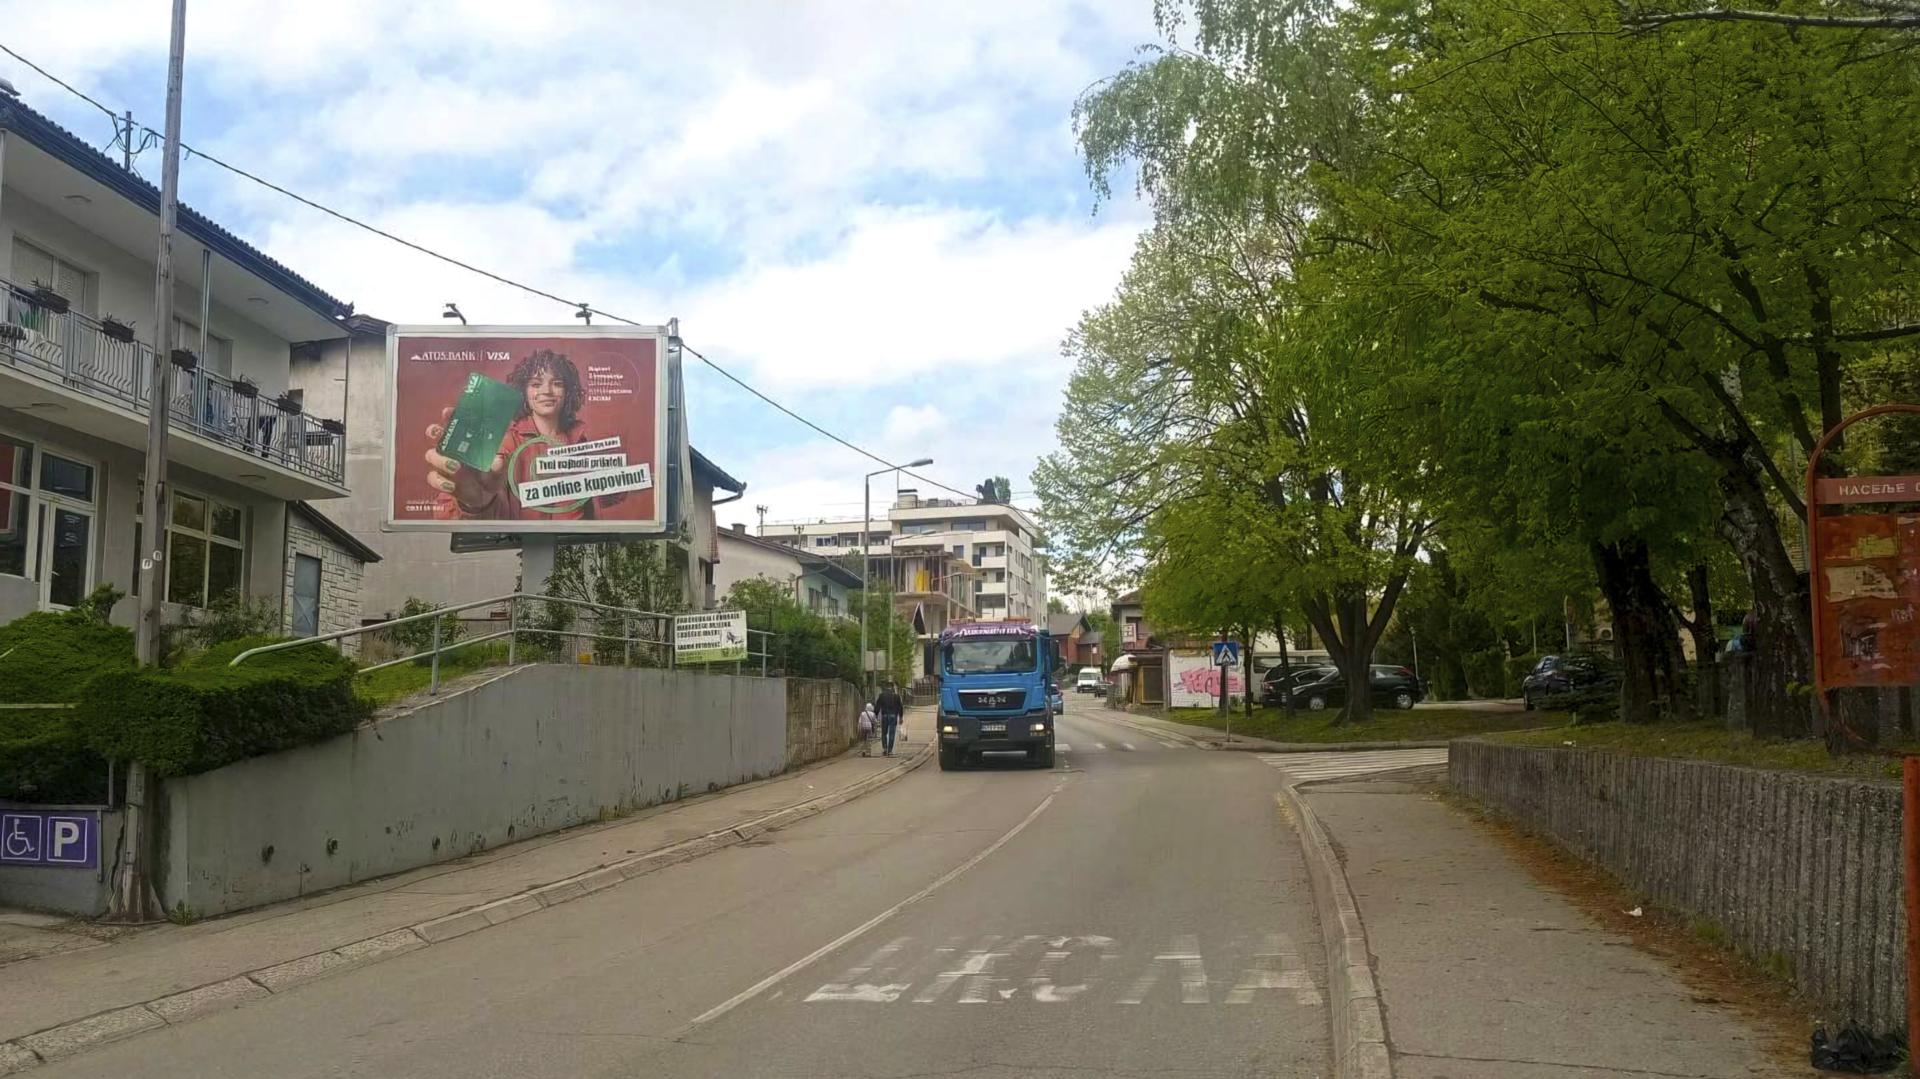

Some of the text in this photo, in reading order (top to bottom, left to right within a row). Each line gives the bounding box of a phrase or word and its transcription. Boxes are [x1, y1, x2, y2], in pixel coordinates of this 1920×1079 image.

[486, 351, 510, 361] VISA
[525, 468, 646, 501] za online kupovinu!
[1839, 483, 1905, 496] НАСЕЉЕ
[54, 821, 80, 857] P
